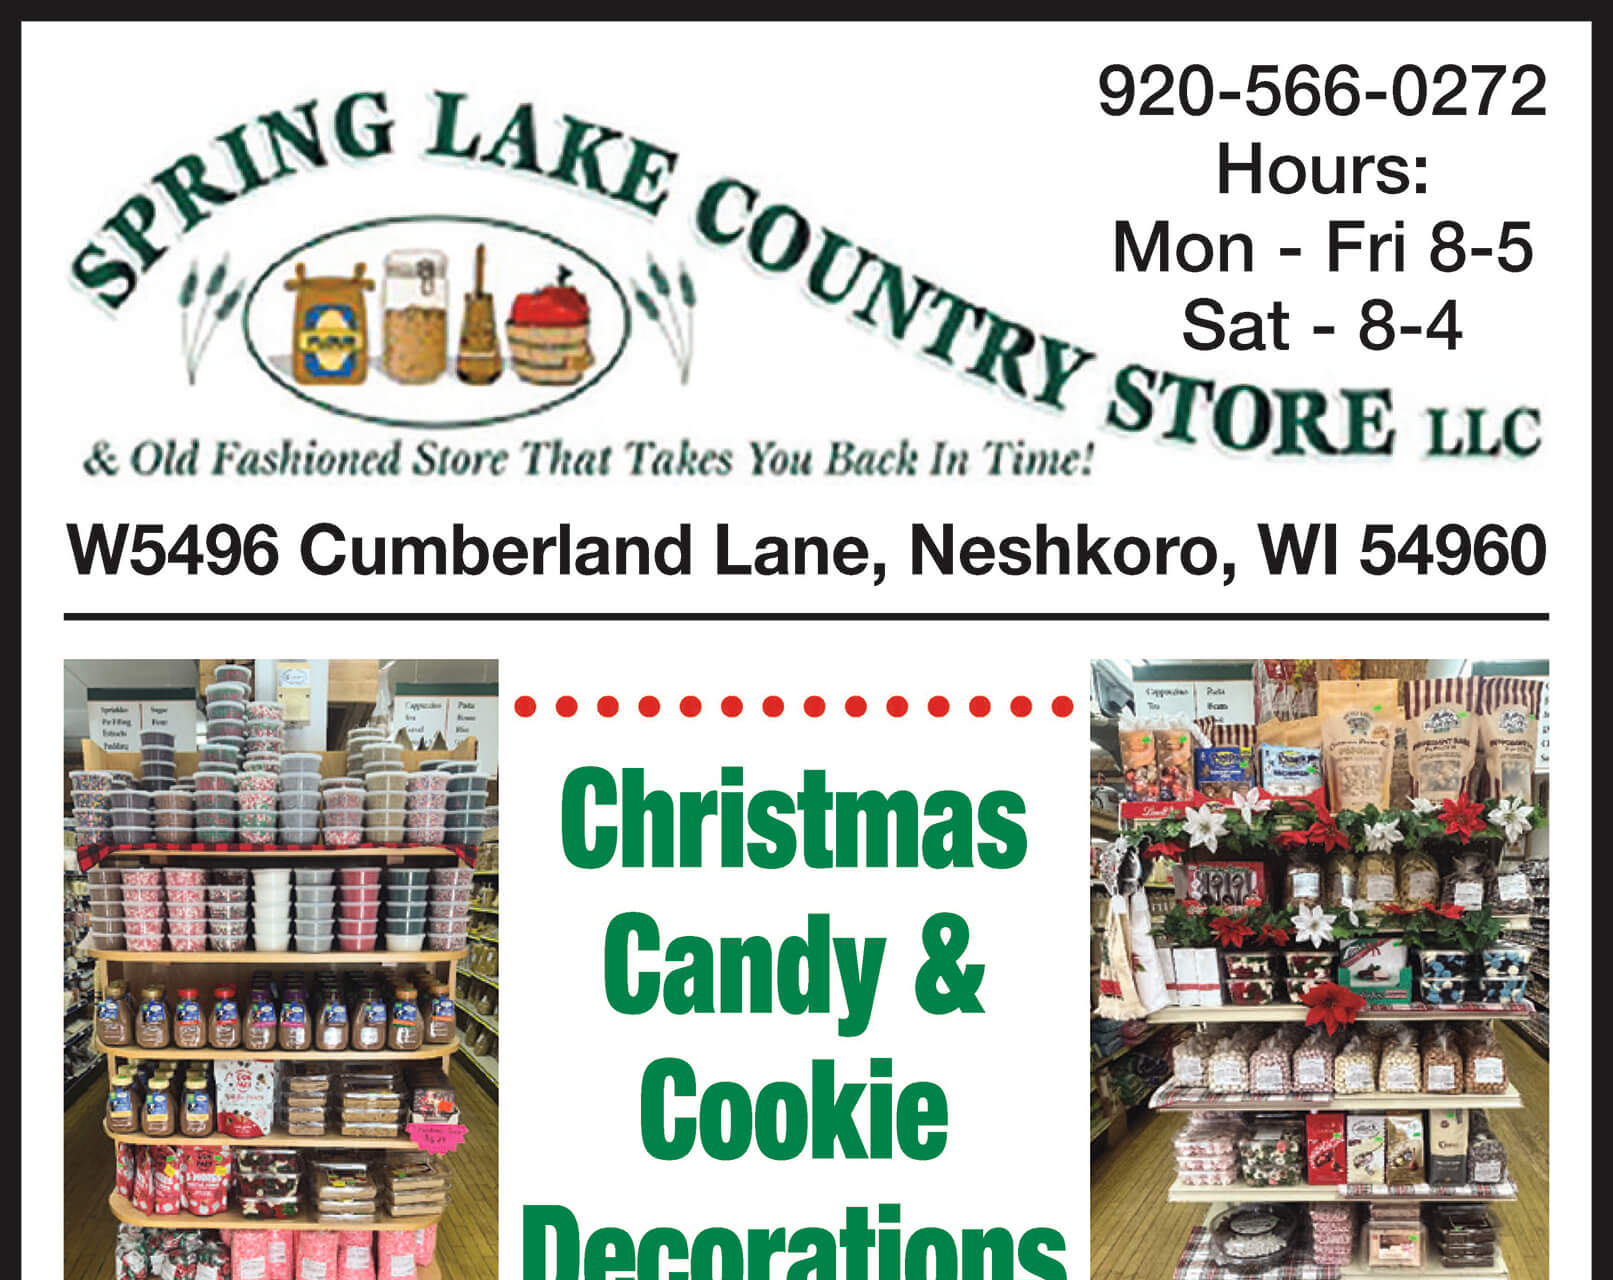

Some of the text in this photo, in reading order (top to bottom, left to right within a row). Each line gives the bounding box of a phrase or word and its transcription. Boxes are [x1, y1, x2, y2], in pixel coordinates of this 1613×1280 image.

[1100, 64, 1546, 116] 920-566-0272
[1220, 142, 1428, 194] Hours:
[70, 90, 1542, 459] SPRING LAKE COUNTRY STORE LLC
[1116, 221, 1532, 272] Mon - Fri 8-5
[1183, 298, 1462, 351] Sat - 8-4
[83, 439, 1094, 476] & Old Fashioned Store That Takes You Back In Time!
[66, 523, 1546, 586] W5496 Cumberland Lane, Neshkoro, WI 54960
[562, 766, 1027, 869] Christmas
[605, 912, 986, 1037] Candy &
[641, 1057, 948, 1160] Cookie
